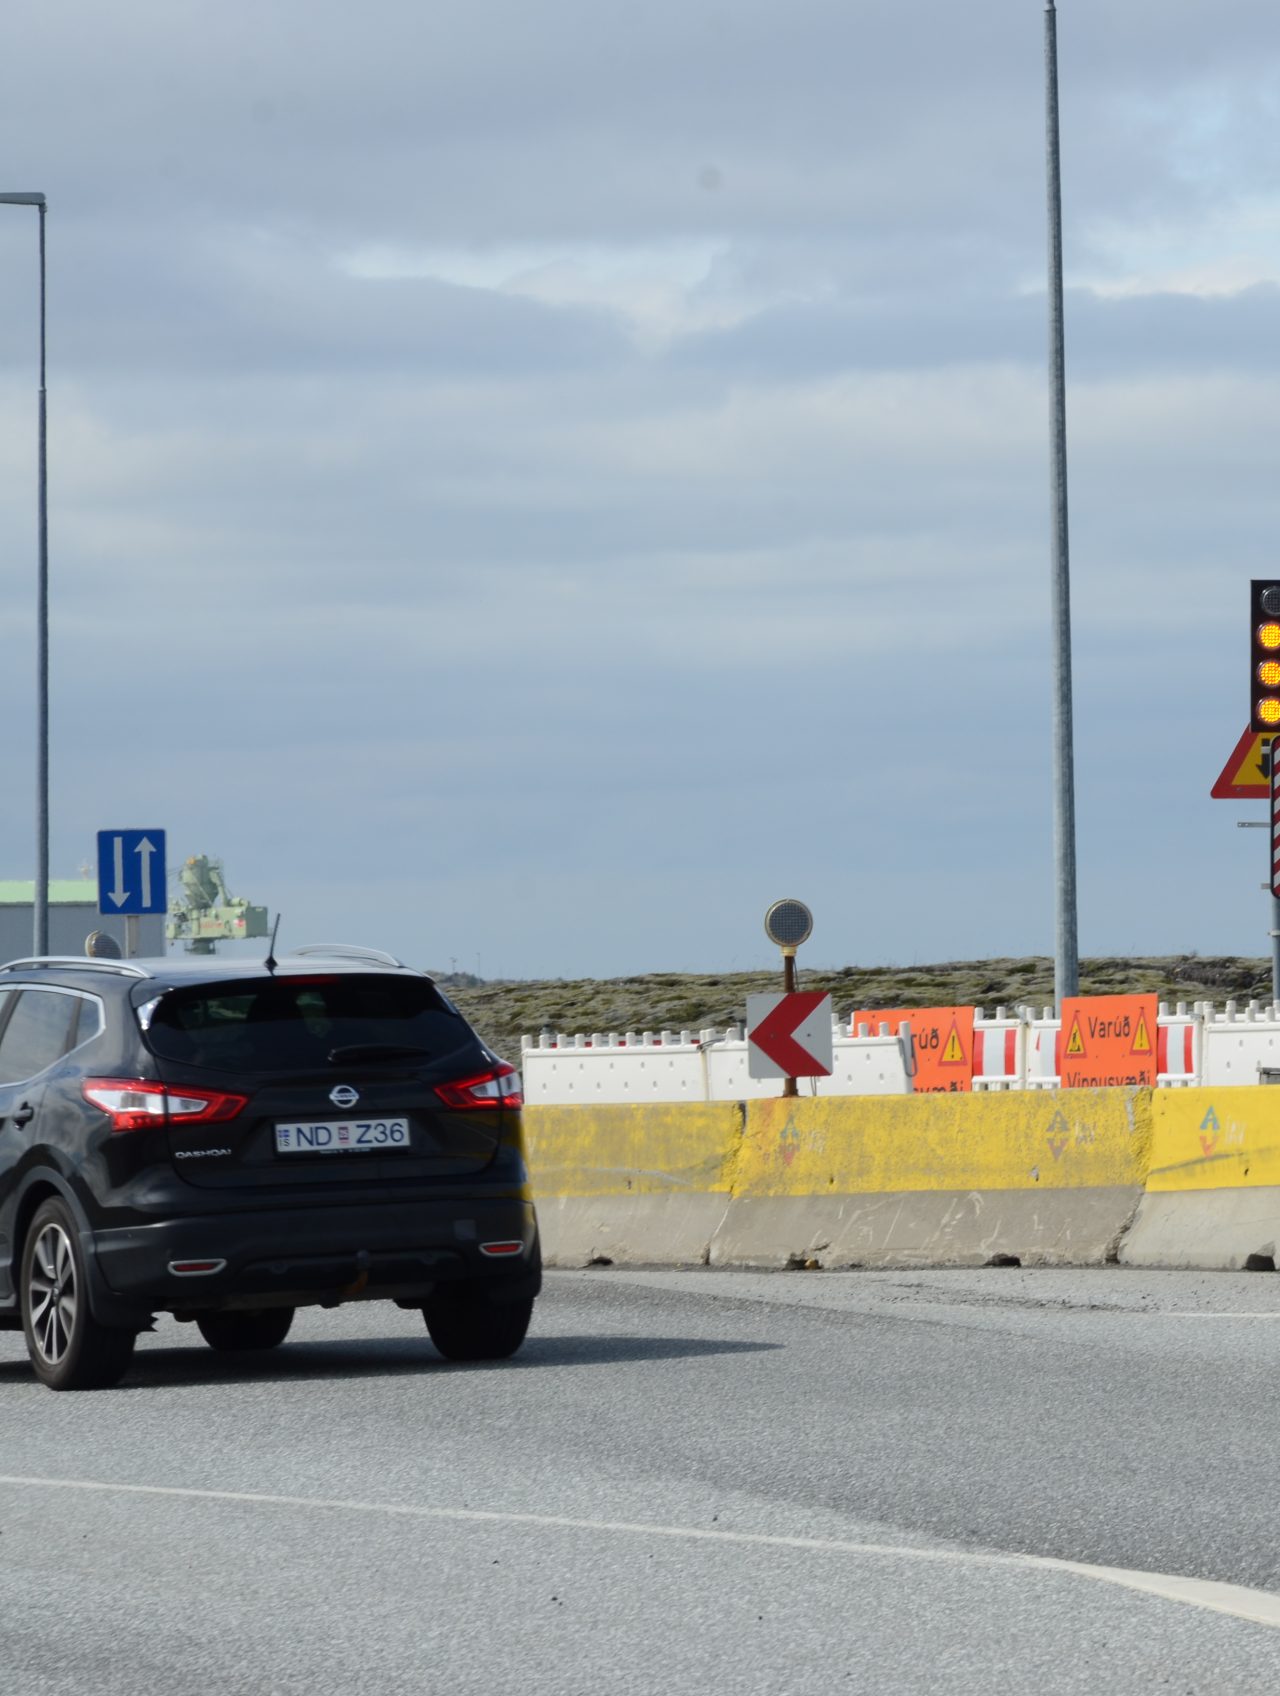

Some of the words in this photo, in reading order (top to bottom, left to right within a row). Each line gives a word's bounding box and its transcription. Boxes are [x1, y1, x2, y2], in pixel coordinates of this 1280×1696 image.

[1088, 1015, 1131, 1039] Varúð
[296, 1126, 332, 1147] ND
[355, 1122, 405, 1144] Z36
